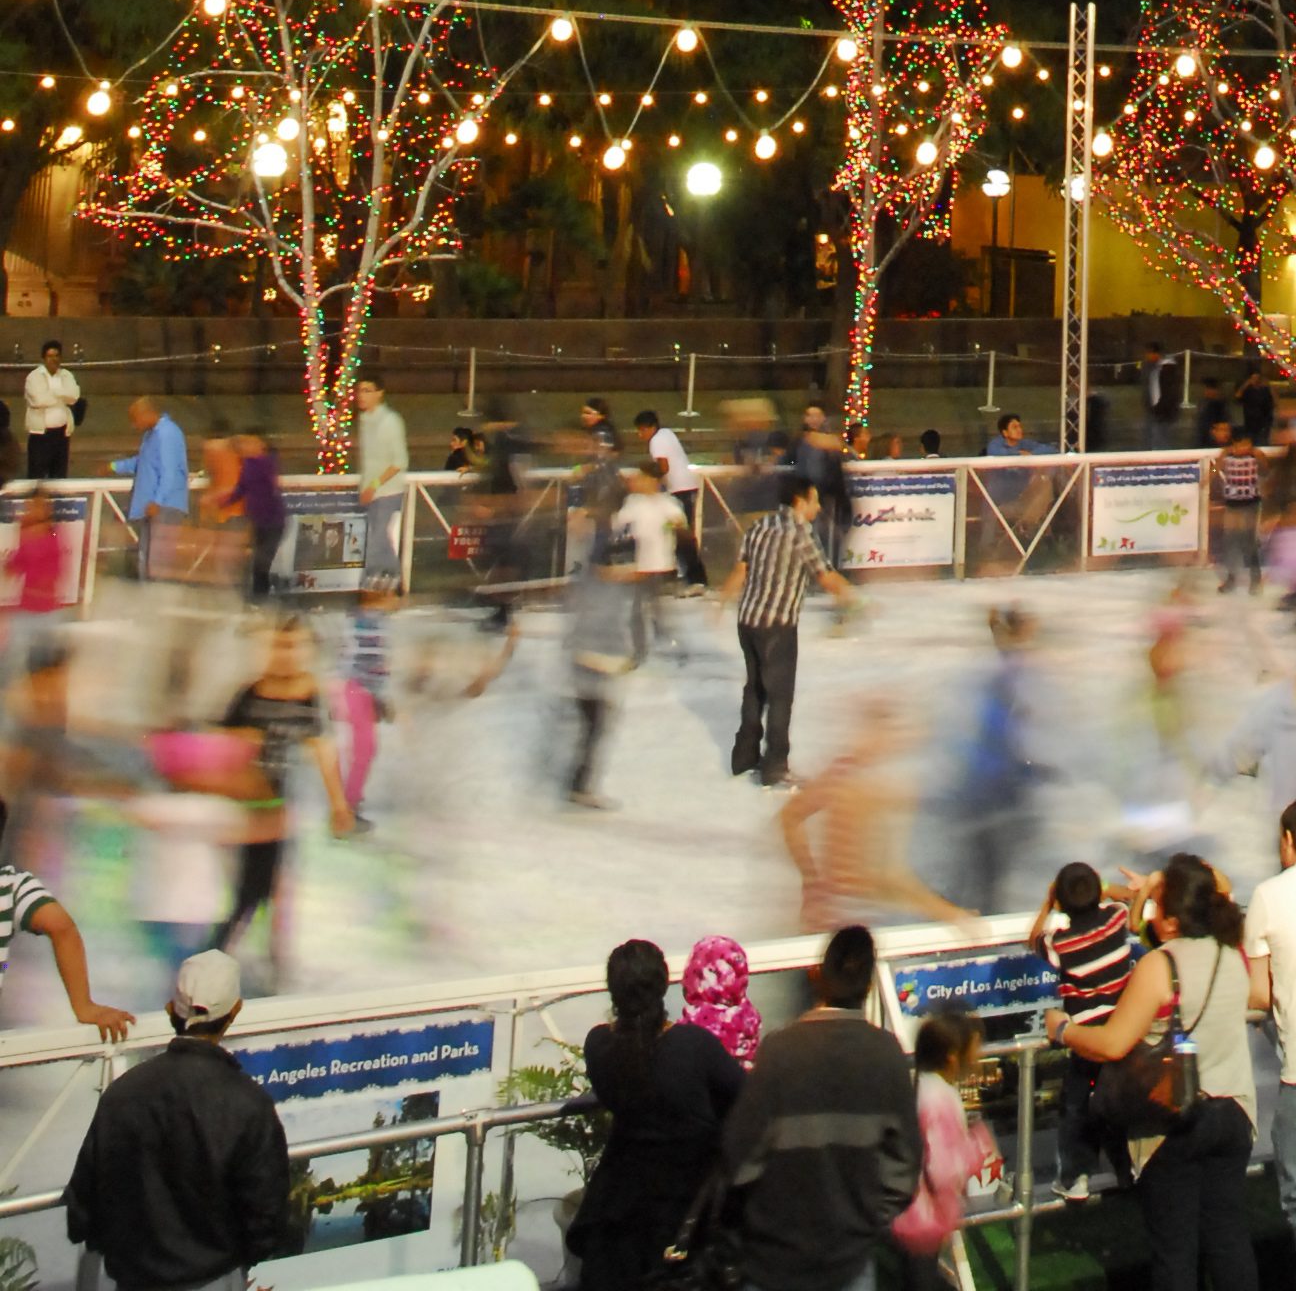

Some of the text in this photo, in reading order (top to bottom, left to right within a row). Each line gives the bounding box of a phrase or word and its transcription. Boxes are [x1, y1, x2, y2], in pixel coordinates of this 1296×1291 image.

[927, 984, 952, 1000] City
[955, 980, 969, 996] of
[970, 979, 991, 995] Los
[994, 973, 1040, 992] Angeles
[268, 1064, 327, 1085] Angeles
[330, 1053, 409, 1076] Recreation
[411, 1046, 438, 1064] and
[441, 1041, 480, 1059] Parks
